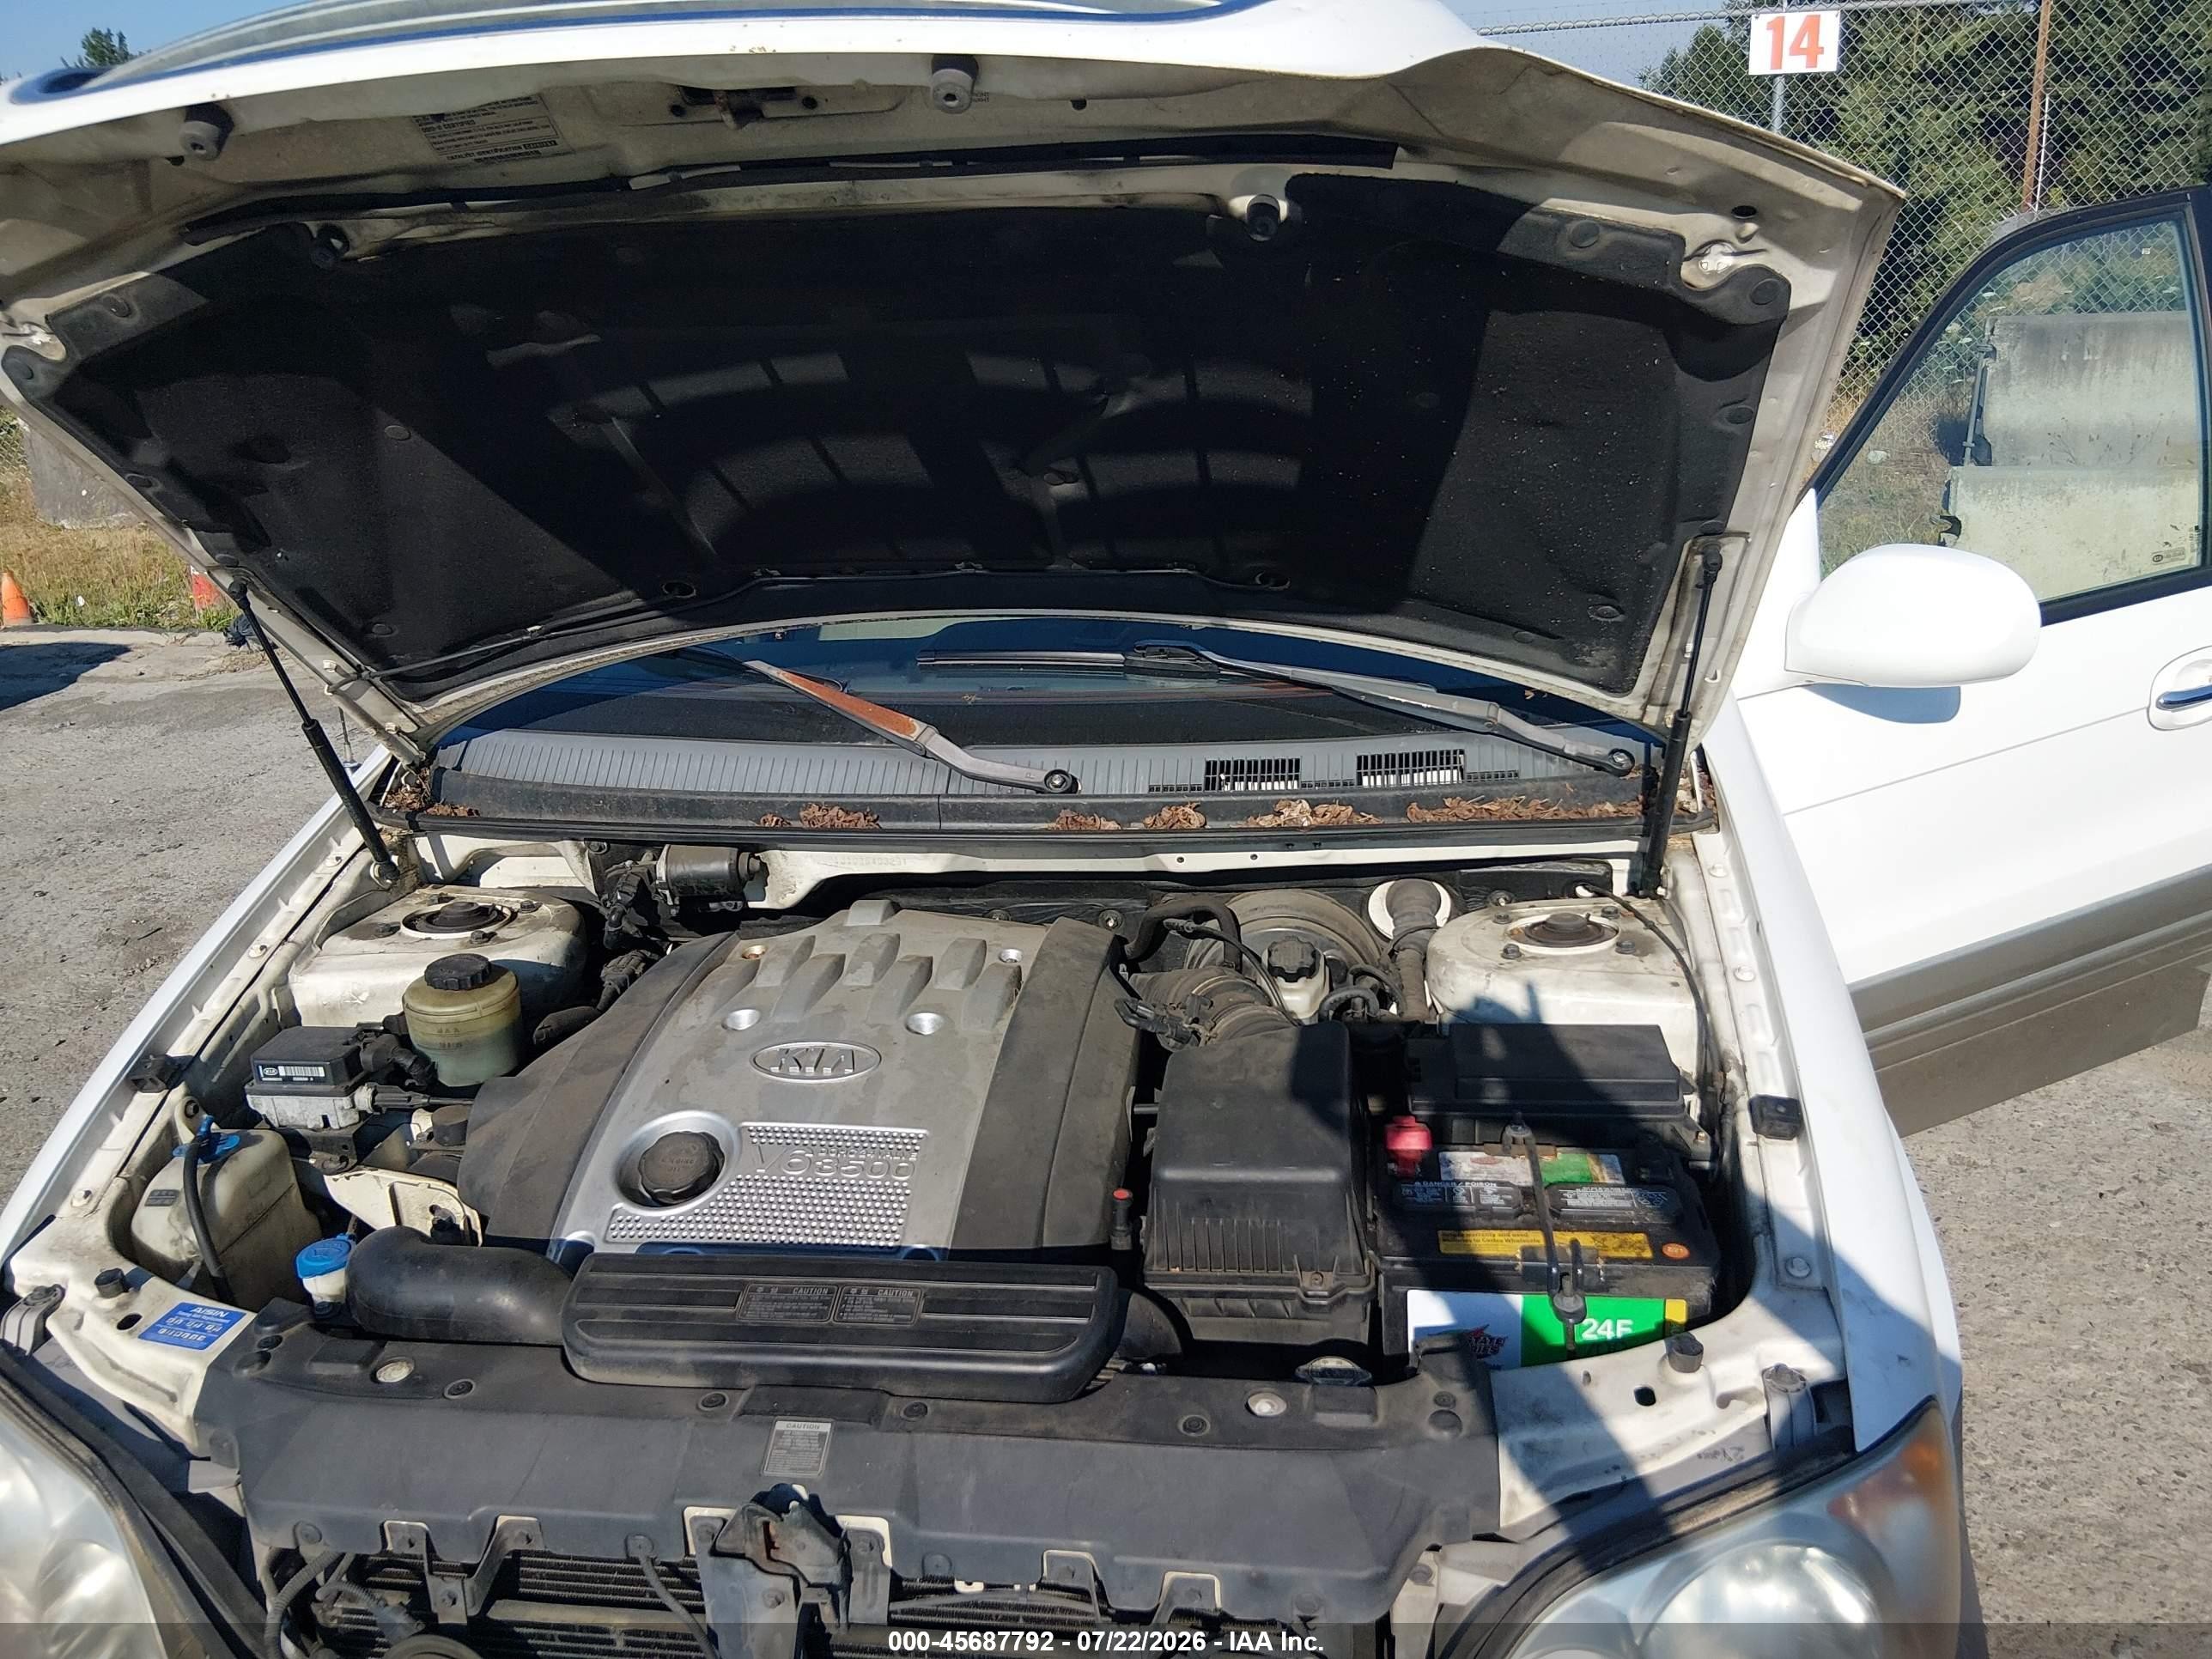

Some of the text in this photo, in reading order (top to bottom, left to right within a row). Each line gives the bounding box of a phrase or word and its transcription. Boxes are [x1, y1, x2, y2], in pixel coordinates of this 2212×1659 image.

[1766, 14, 1825, 70] 14
[770, 1048, 856, 1074] KIA
[814, 1156, 916, 1181] 3500
[792, 1287, 830, 1296] CAUTION
[878, 1288, 915, 1297] CAUTION
[189, 1306, 229, 1318] AISIN
[1581, 1318, 1634, 1340] 24F
